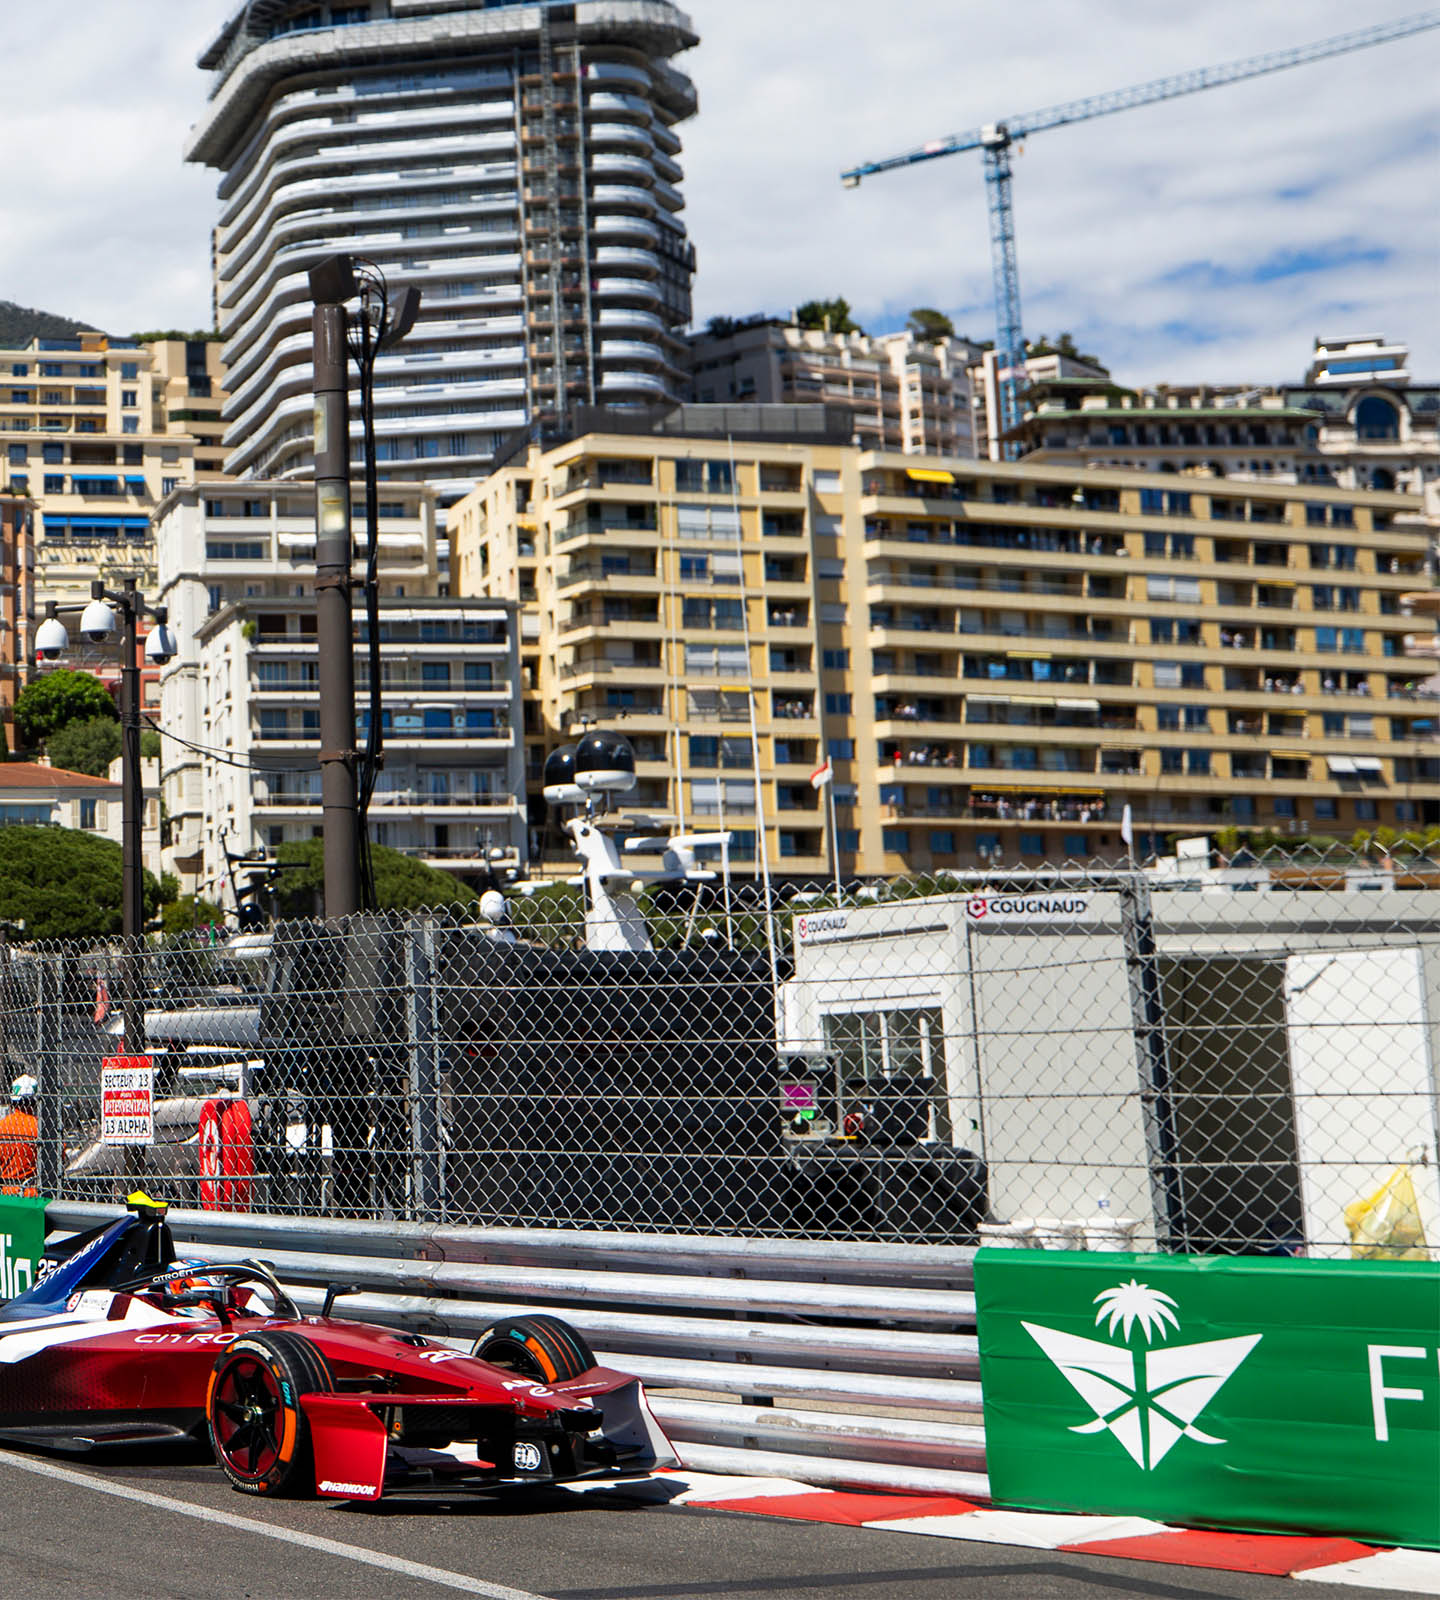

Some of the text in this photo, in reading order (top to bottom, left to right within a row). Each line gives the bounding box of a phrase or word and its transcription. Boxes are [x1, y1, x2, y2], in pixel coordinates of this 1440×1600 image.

[990, 900, 1087, 914] COUGNAUD
[104, 1073, 149, 1088] SECTEUR 13
[105, 1118, 148, 1134] 13 ALPHA
[134, 1331, 240, 1344] CITRO
[1367, 1344, 1440, 1441] F
